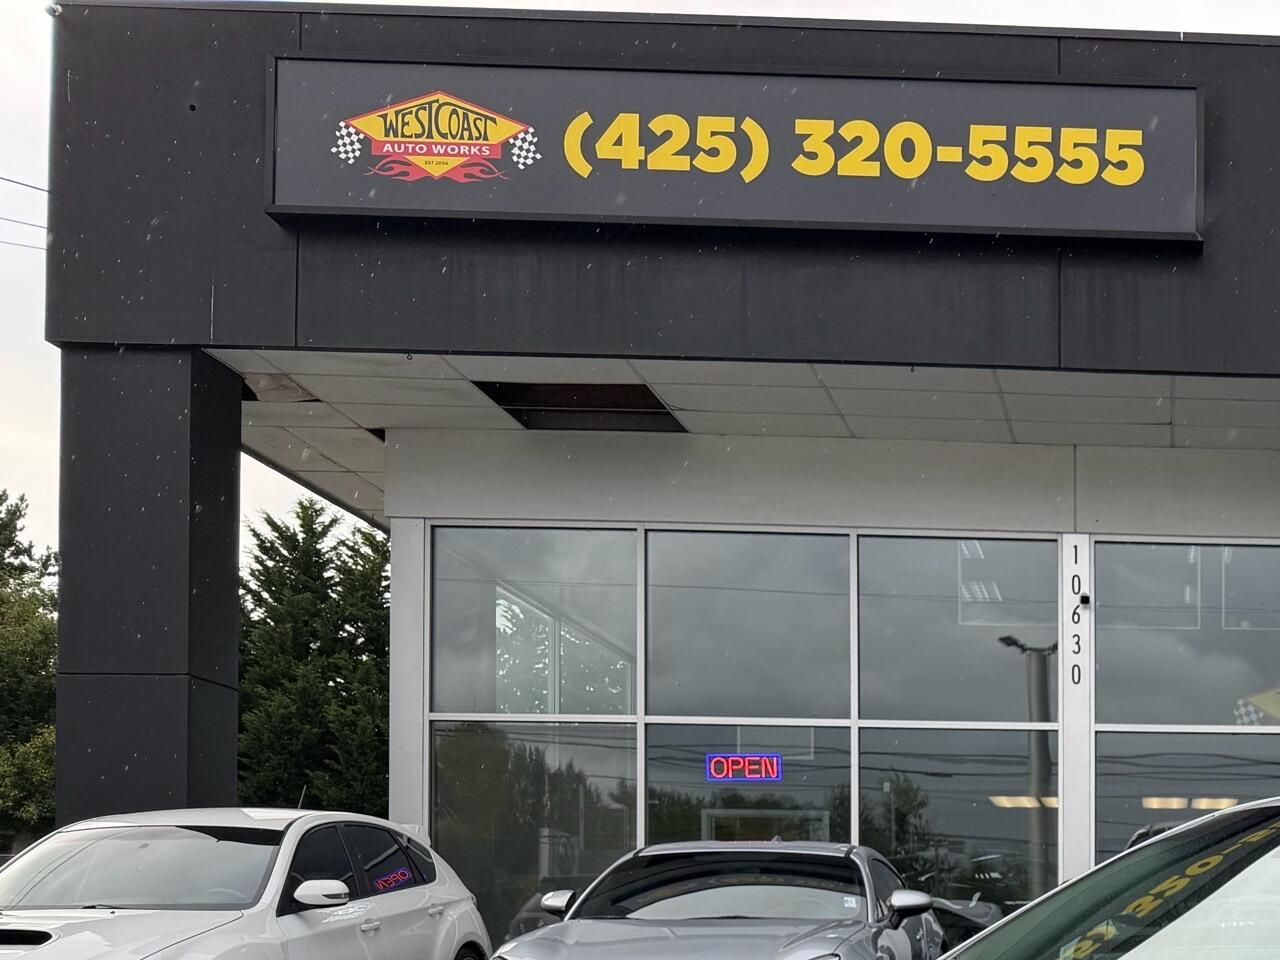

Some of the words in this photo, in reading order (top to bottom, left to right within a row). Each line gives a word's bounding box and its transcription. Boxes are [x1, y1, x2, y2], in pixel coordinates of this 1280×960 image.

[382, 143, 428, 154] AUTO
[432, 144, 491, 155] WORKS
[563, 111, 770, 184] (425)
[790, 118, 1145, 187] 320-5555
[1071, 545, 1081, 685] 10630
[710, 756, 778, 779] OPEN
